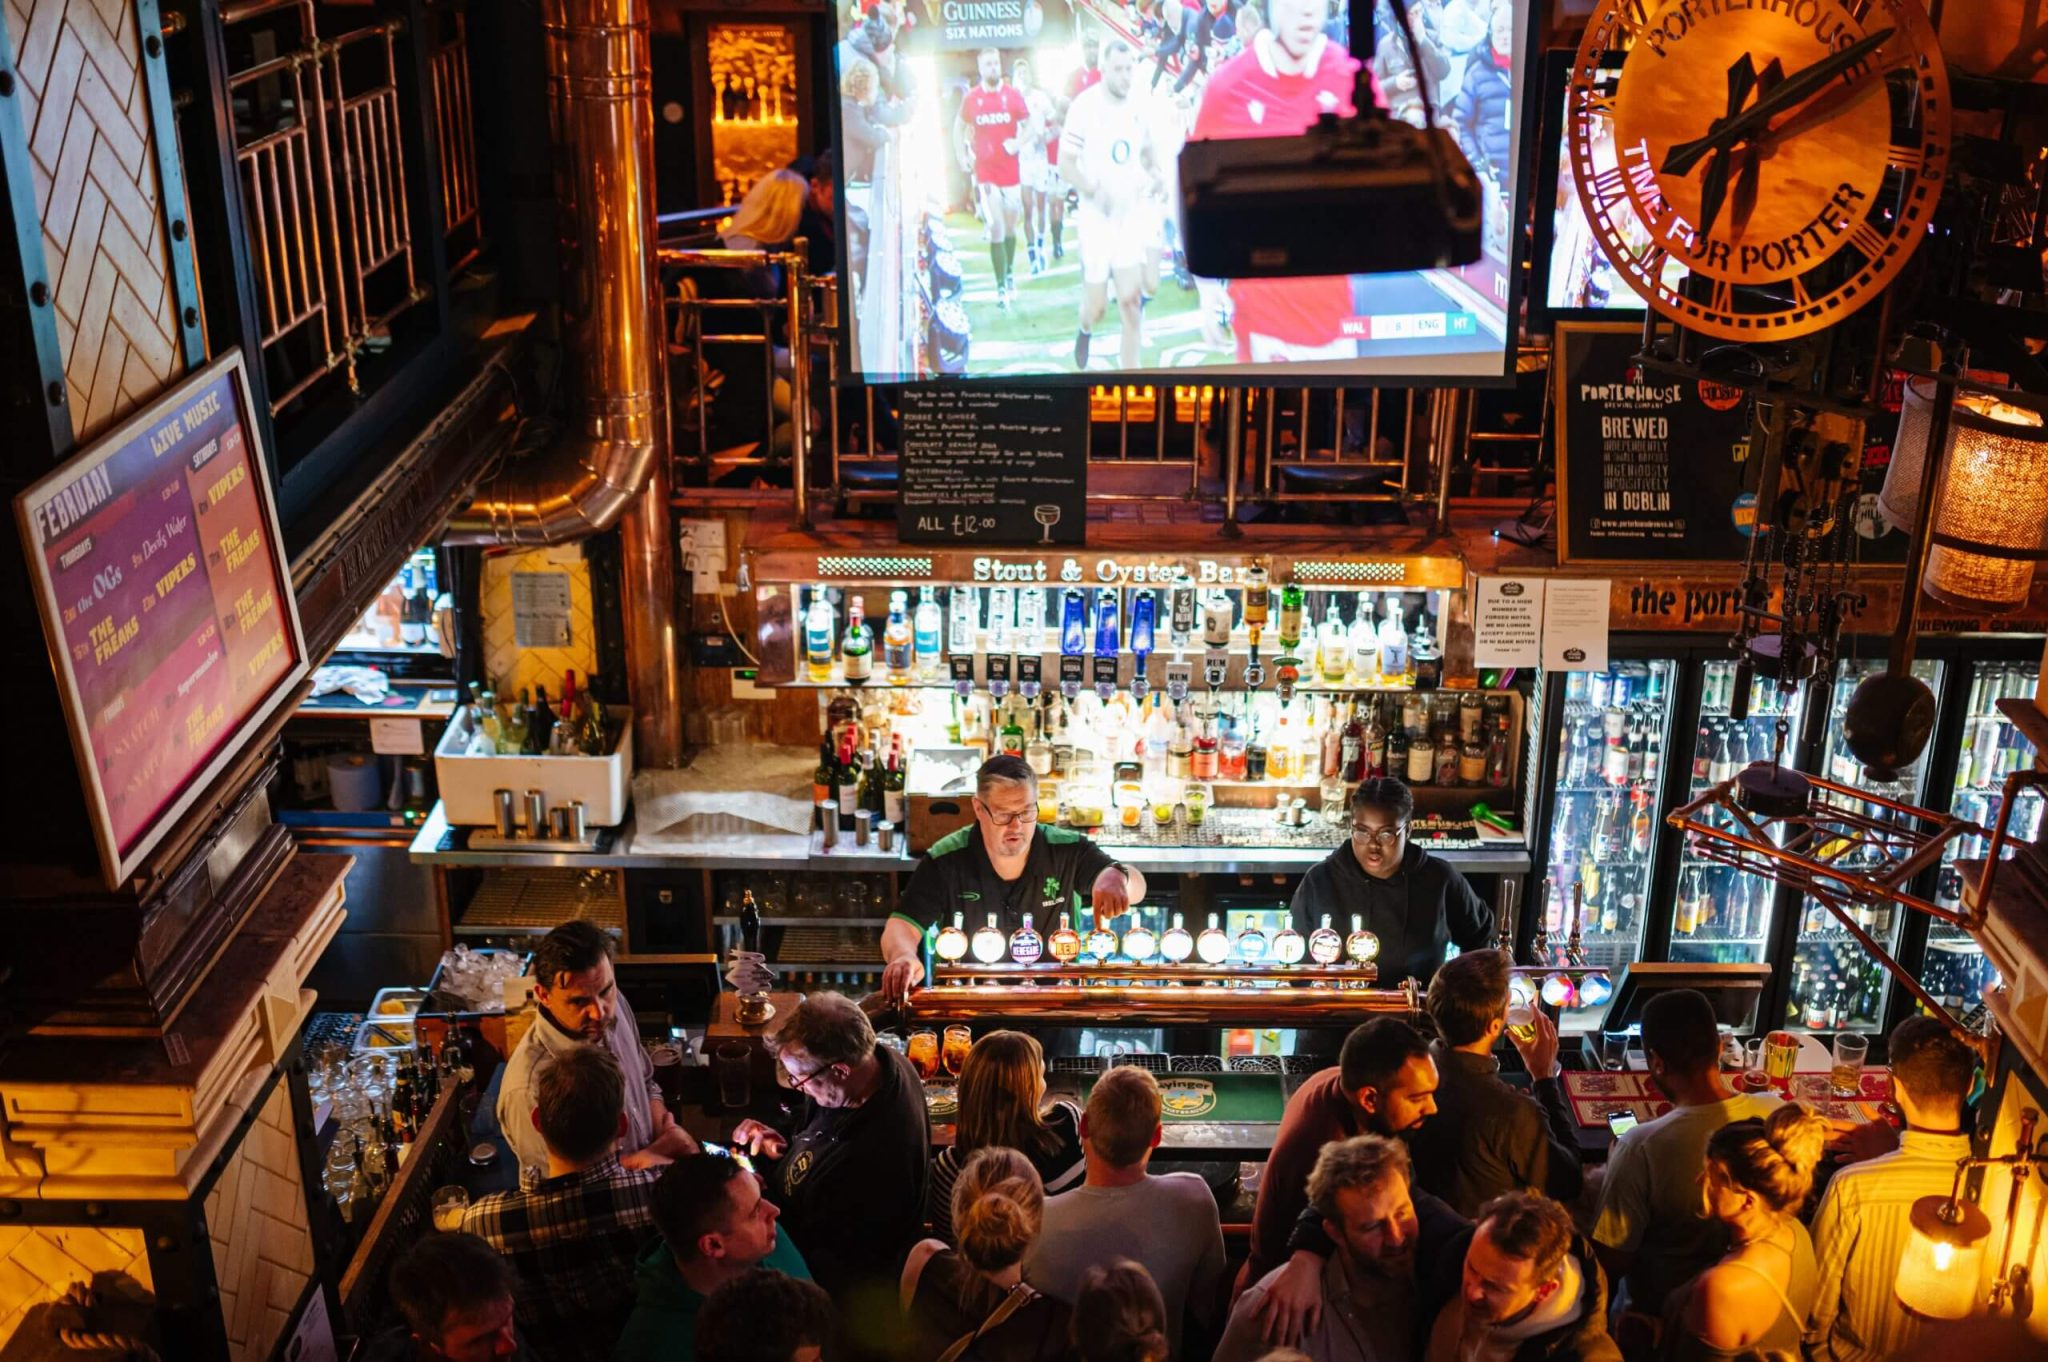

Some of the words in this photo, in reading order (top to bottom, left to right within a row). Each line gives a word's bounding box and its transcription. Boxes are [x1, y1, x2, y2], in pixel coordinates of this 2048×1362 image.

[943, 1, 1022, 21] GUINNESS
[945, 26, 966, 40] SIX
[969, 23, 1023, 38] NATIONS
[976, 112, 1011, 125] CAZOO
[1624, 138, 1672, 224] TIME
[1665, 215, 1731, 273] FOR
[1741, 183, 1867, 274] PORTER
[1342, 321, 1366, 335] WAL
[1418, 319, 1440, 330] ENG
[1453, 316, 1469, 330] HT
[1581, 384, 1681, 404] PORTERHOUSE
[150, 419, 184, 458] LIVE
[182, 390, 221, 433] MUSIC
[1602, 416, 1669, 439] BREWED
[208, 462, 245, 507] VIPERS
[34, 464, 113, 545] FEBRUARY
[1604, 491, 1617, 511] IN
[1623, 491, 1670, 511] DUBLIN
[918, 516, 945, 531] ALL
[220, 527, 241, 556] THE
[226, 528, 260, 573] FREAKS
[155, 551, 197, 598] VIPERS
[973, 558, 1047, 582] Stout
[1061, 558, 1083, 582] &
[1096, 559, 1187, 586] Oyster
[1199, 560, 1251, 583] Bar
[1631, 583, 1677, 616] the
[89, 614, 116, 647] THE
[95, 614, 140, 667] FREAKS
[956, 664, 968, 672] GIN
[992, 664, 1005, 672] GIN
[1023, 664, 1035, 673] GIN
[1063, 664, 1081, 672] VODKA
[1096, 665, 1114, 674] VODKA
[1207, 658, 1226, 667] RUM
[1168, 673, 1188, 681] RUM
[1042, 896, 1065, 907] IRELAND
